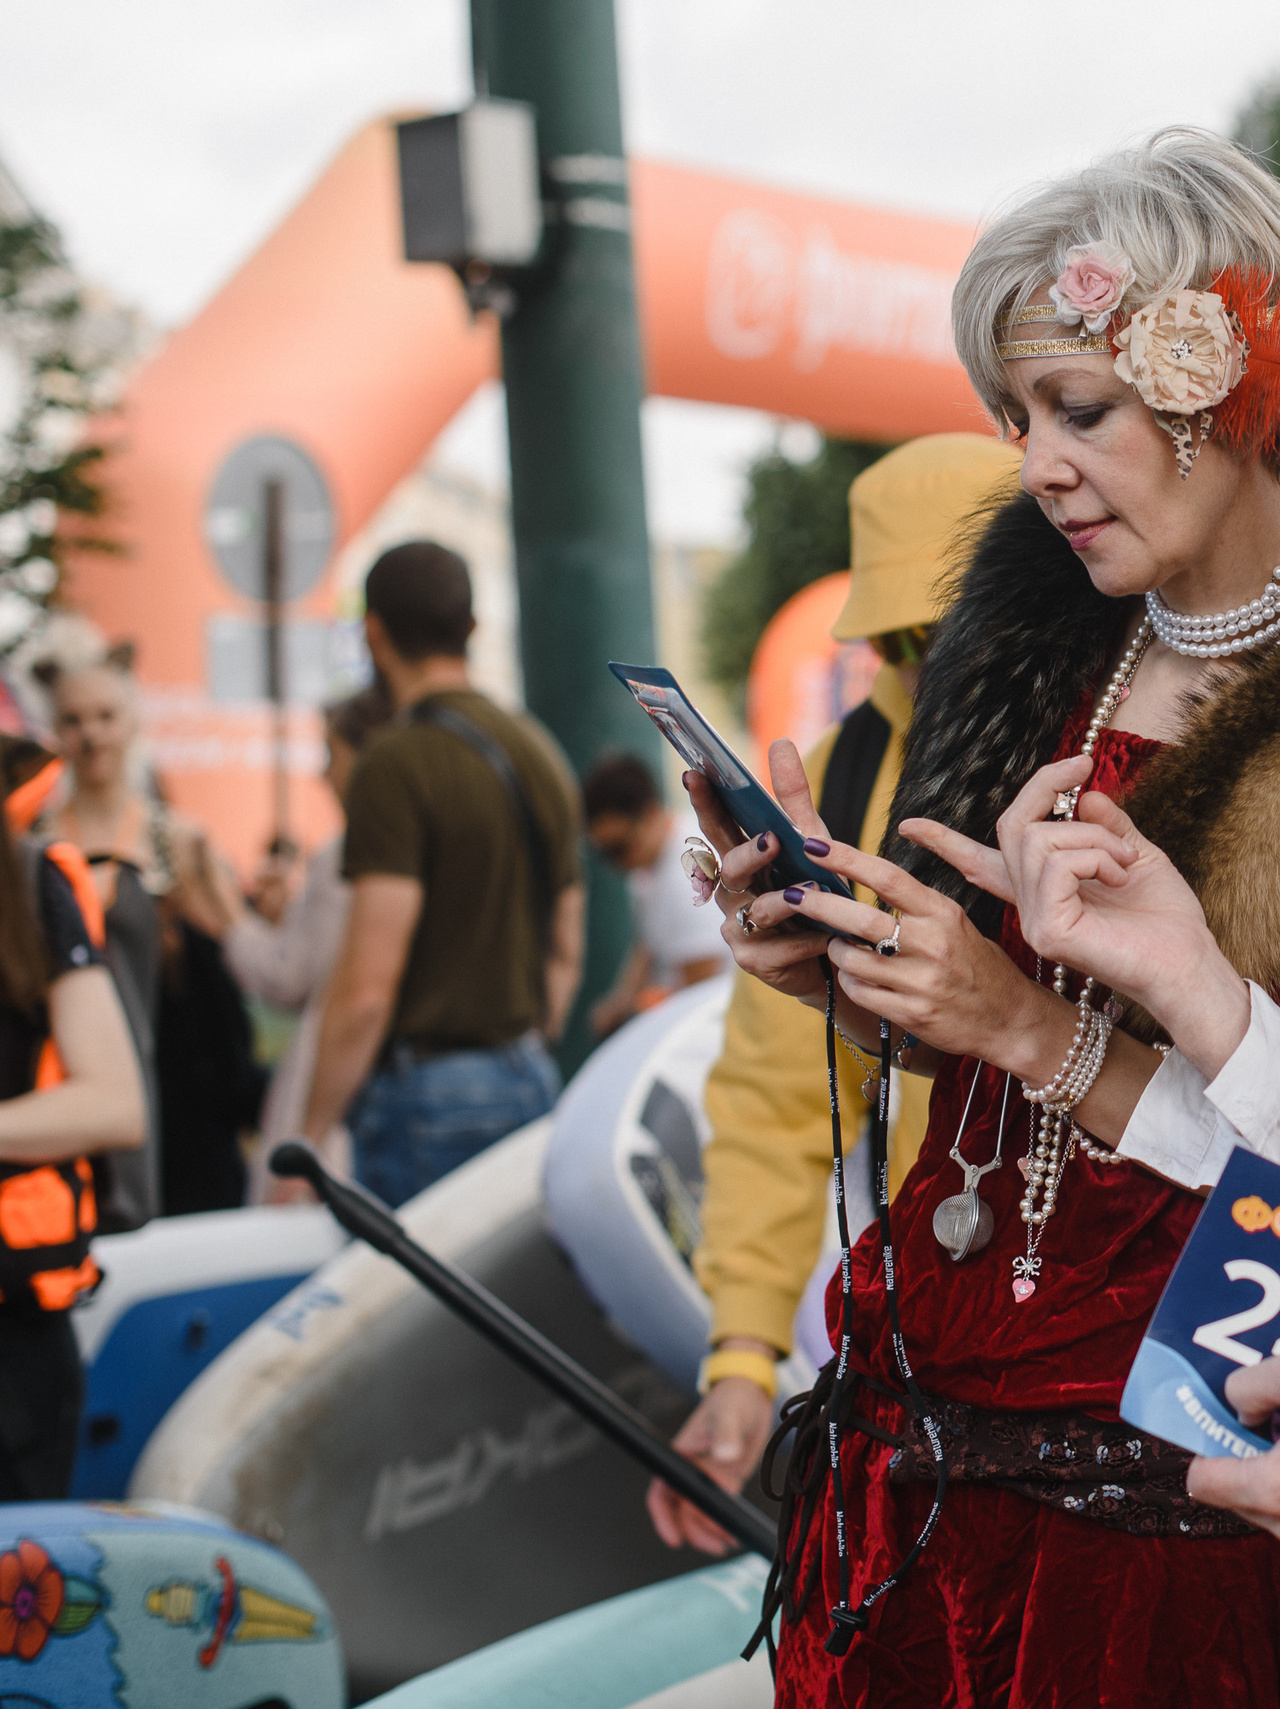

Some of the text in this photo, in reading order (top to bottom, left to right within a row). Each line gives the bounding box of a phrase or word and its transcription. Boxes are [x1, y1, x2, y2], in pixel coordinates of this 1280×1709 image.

[833, 1157, 842, 1204] Naturehike
[841, 1247, 852, 1294] Naturehike
[883, 1245, 895, 1291] Naturehike
[836, 1334, 851, 1380] Naturehike
[829, 1422, 841, 1469] Naturehike
[923, 1415, 944, 1462] Naturehike
[836, 1510, 847, 1557] Naturehike
